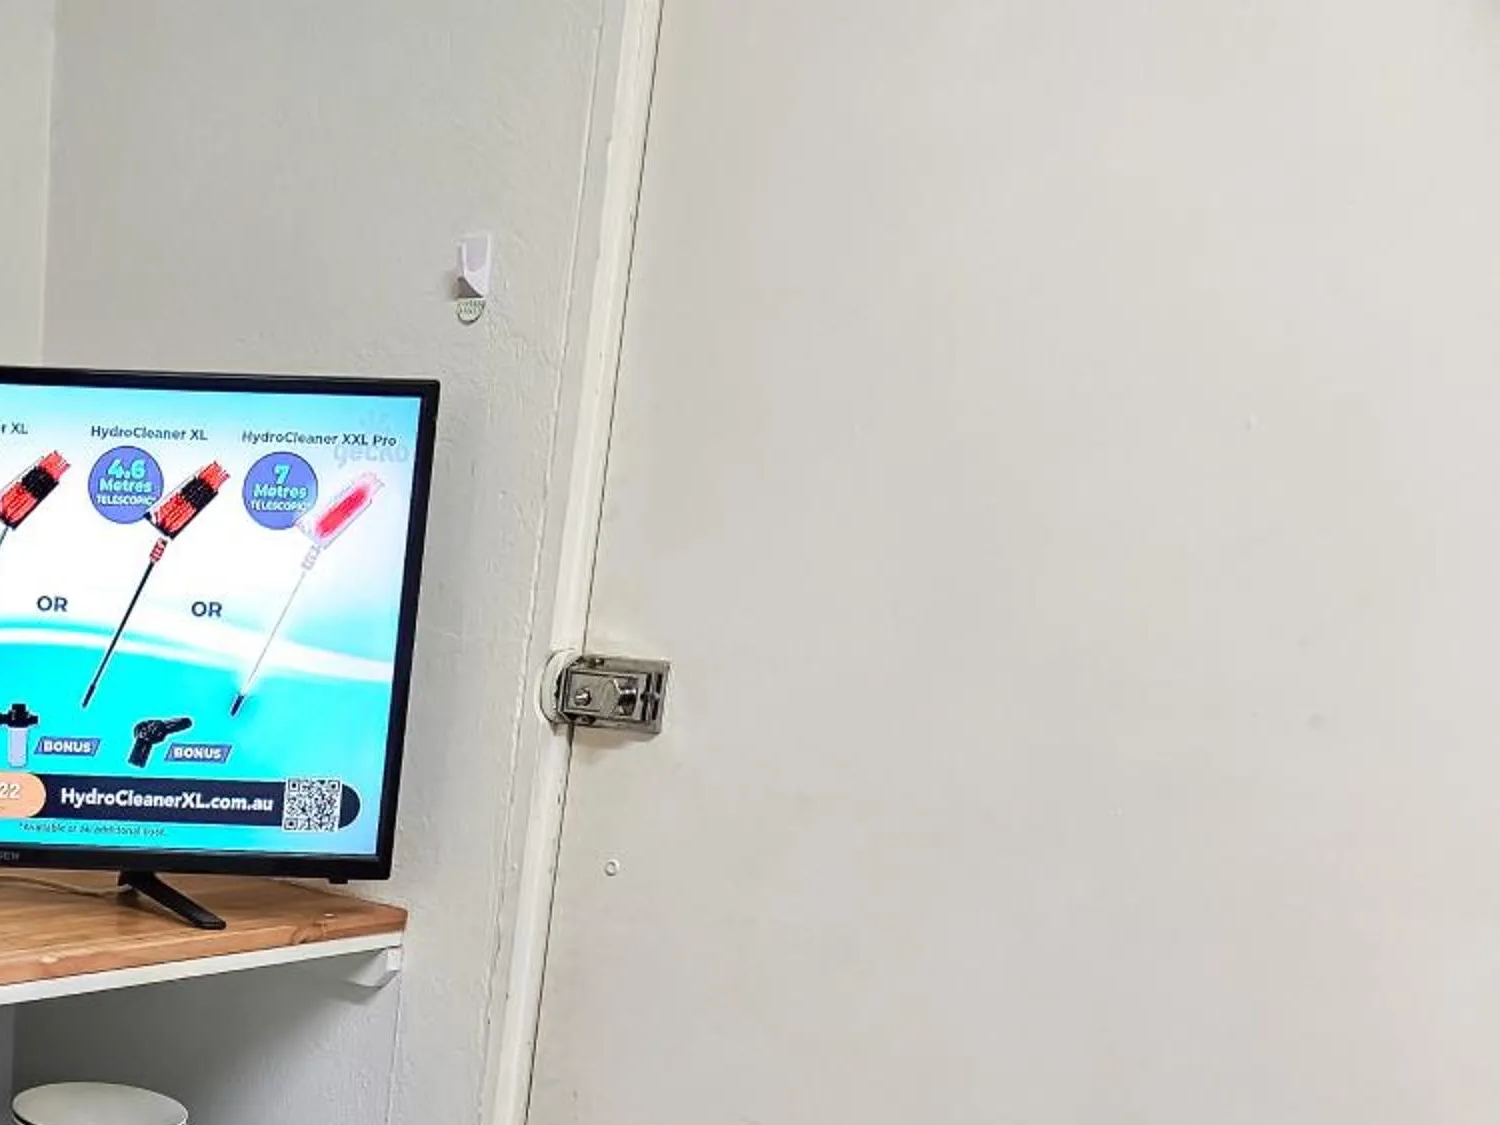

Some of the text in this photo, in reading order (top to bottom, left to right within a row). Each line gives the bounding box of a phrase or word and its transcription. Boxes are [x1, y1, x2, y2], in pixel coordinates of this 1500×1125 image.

[10, 421, 29, 435] XL
[91, 425, 209, 441] HydroCleaner XL
[242, 431, 397, 447] HydroCleaner XXL Pro
[107, 458, 147, 480] 4.6
[273, 463, 291, 484] 7
[37, 595, 68, 613] OR
[191, 600, 223, 618] OR
[43, 741, 92, 754] BONUS
[173, 747, 223, 760] BONUS
[61, 787, 275, 812] HydroCleanerXL.com.au
